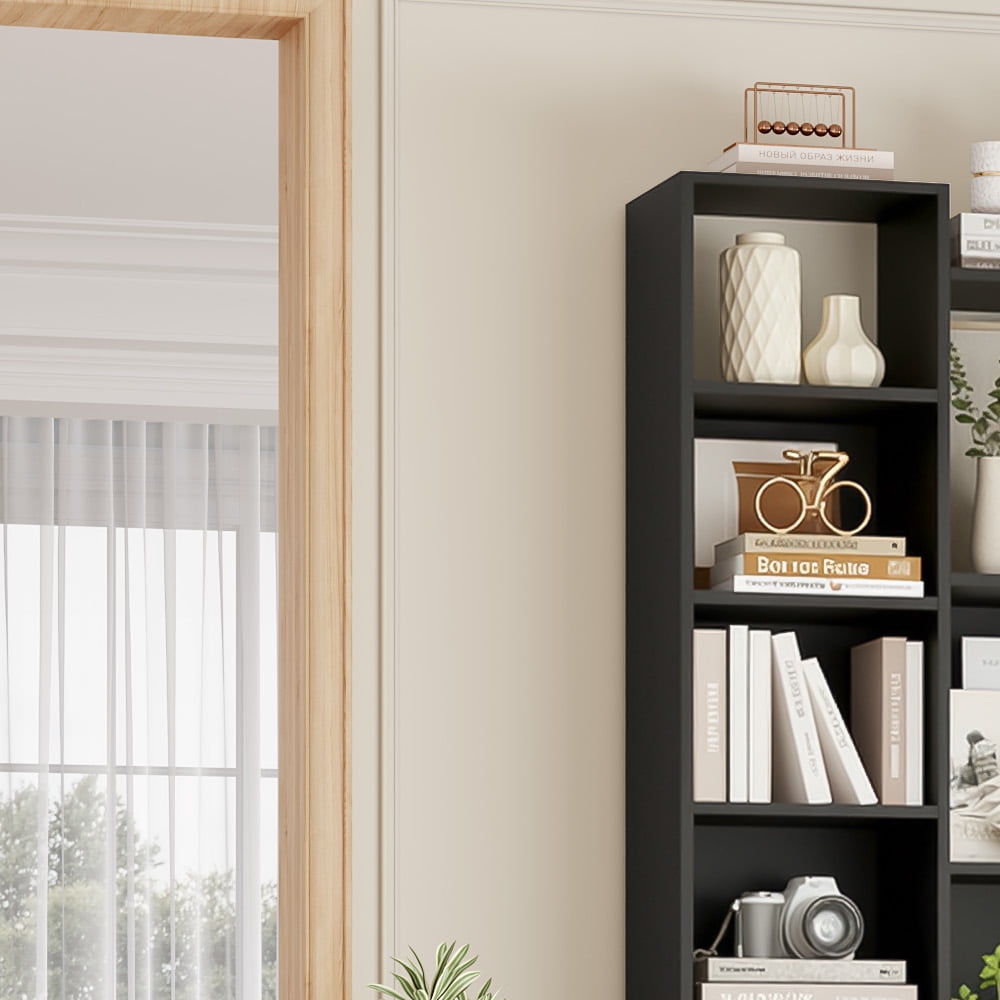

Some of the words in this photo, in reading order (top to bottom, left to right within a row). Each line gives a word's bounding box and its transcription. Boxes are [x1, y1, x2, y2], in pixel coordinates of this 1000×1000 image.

[759, 151, 797, 160] НОВЫЙ
[800, 153, 833, 161] ОБРАЗ
[836, 154, 875, 163] ЖИЗНИ
